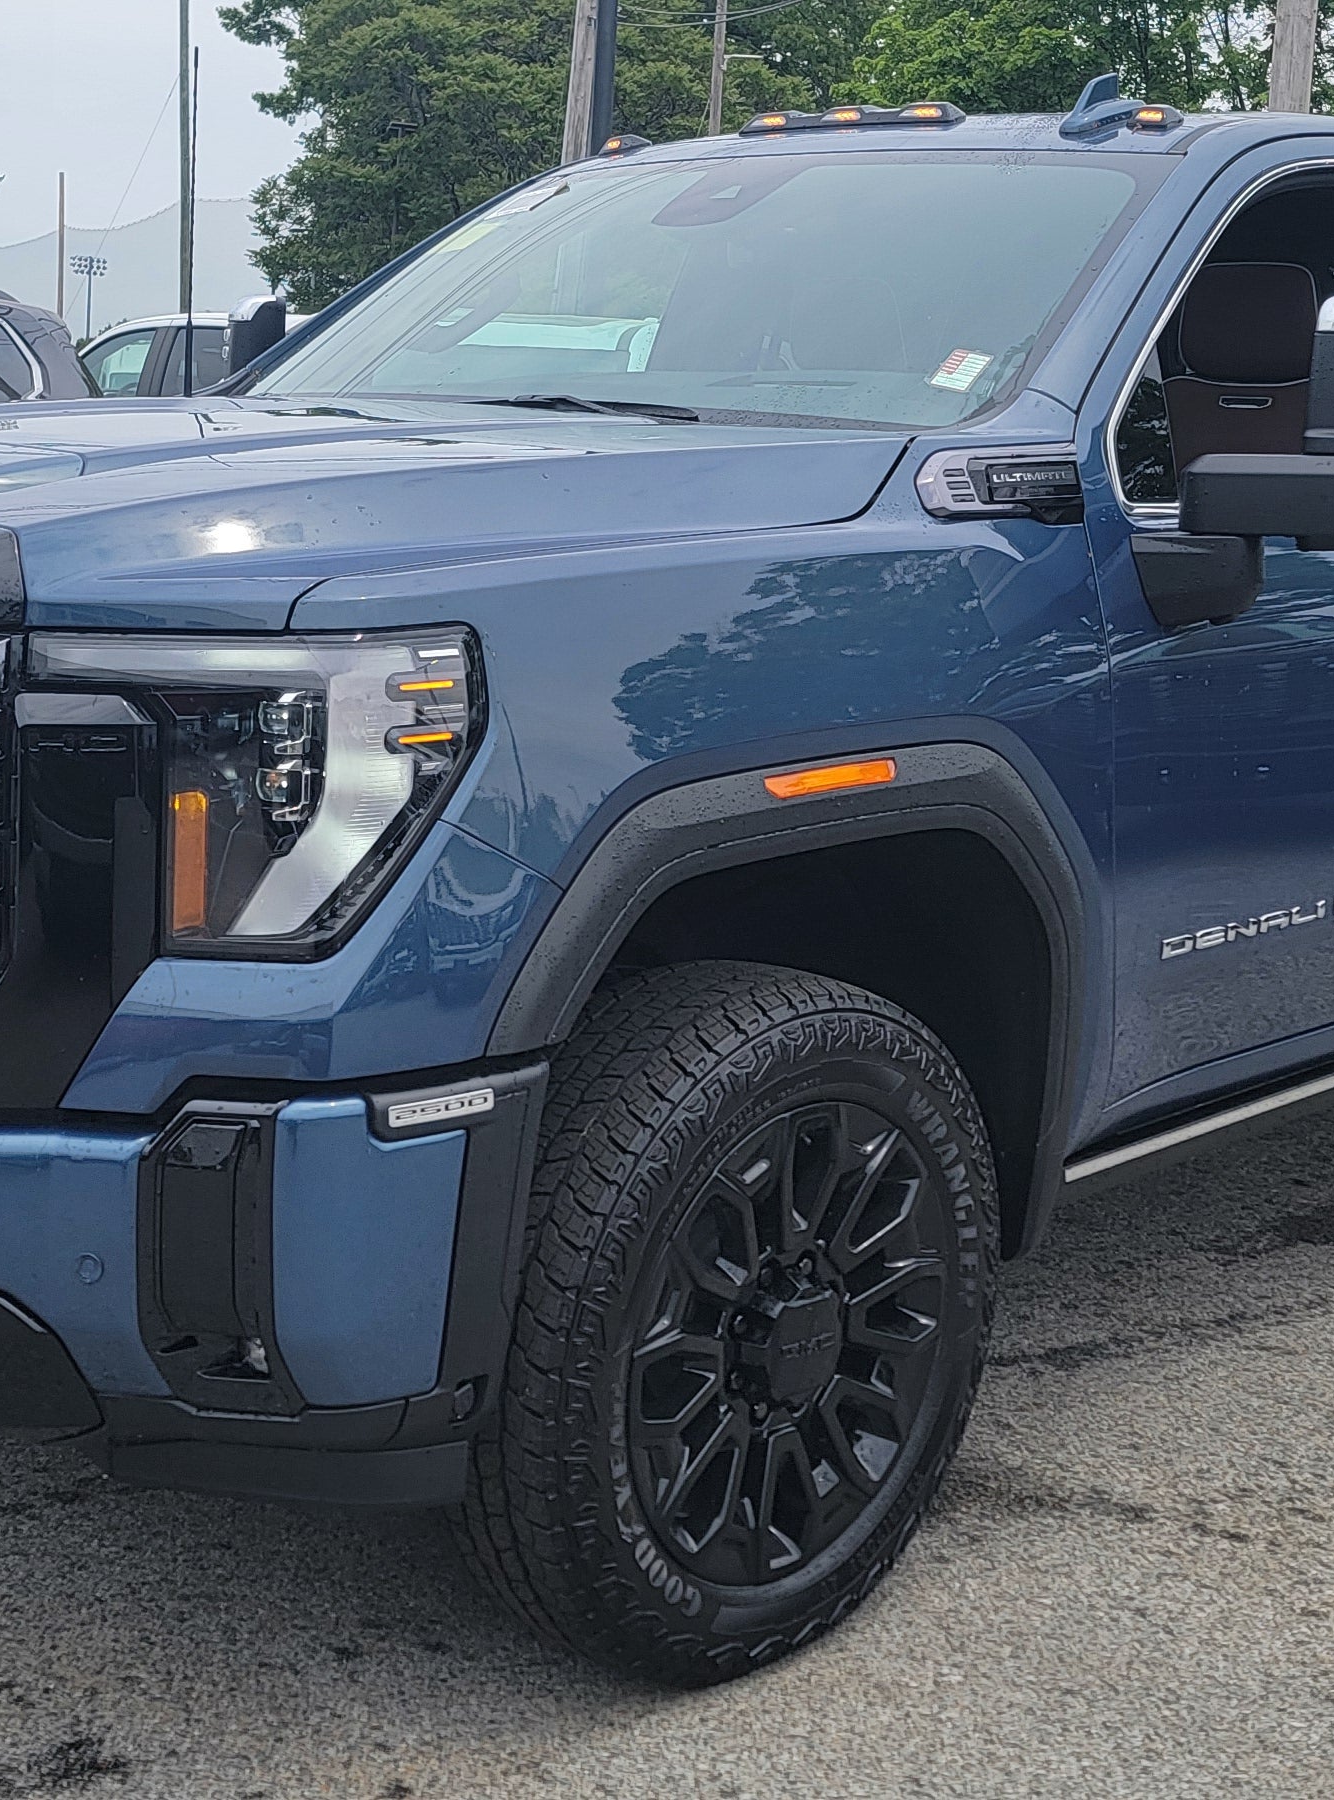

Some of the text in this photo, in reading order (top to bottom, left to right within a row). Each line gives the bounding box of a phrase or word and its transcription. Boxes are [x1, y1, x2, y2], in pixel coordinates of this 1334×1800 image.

[992, 470, 1073, 483] ULTIMATE
[1160, 900, 1326, 960] DENALI
[394, 1096, 488, 1121] 2500
[907, 1090, 979, 1308] WRANGLER
